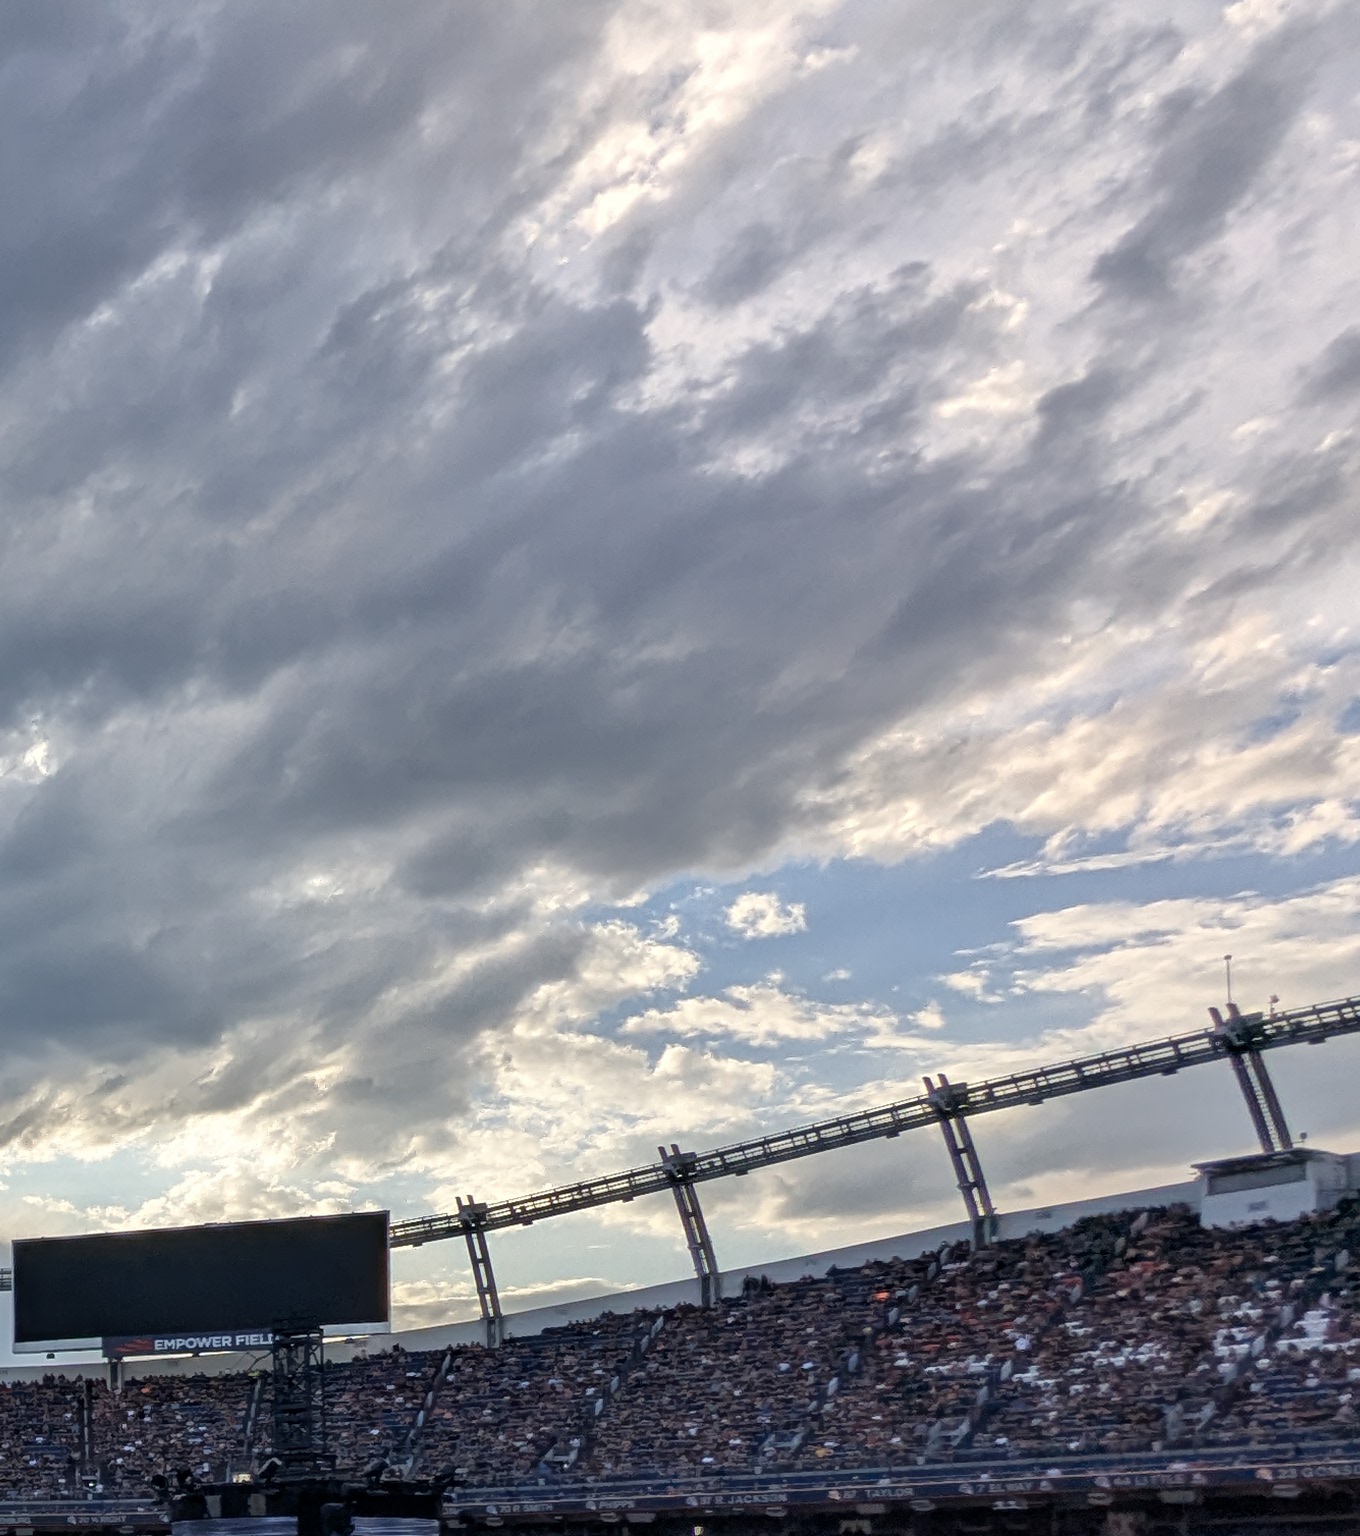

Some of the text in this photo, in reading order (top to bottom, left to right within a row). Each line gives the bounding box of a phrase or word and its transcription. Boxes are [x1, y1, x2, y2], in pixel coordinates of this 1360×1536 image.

[154, 1335, 231, 1350] EMPOWER
[865, 1488, 914, 1498] TAYLOR
[728, 1494, 788, 1504] JACKSON
[523, 1504, 554, 1512] SMITH
